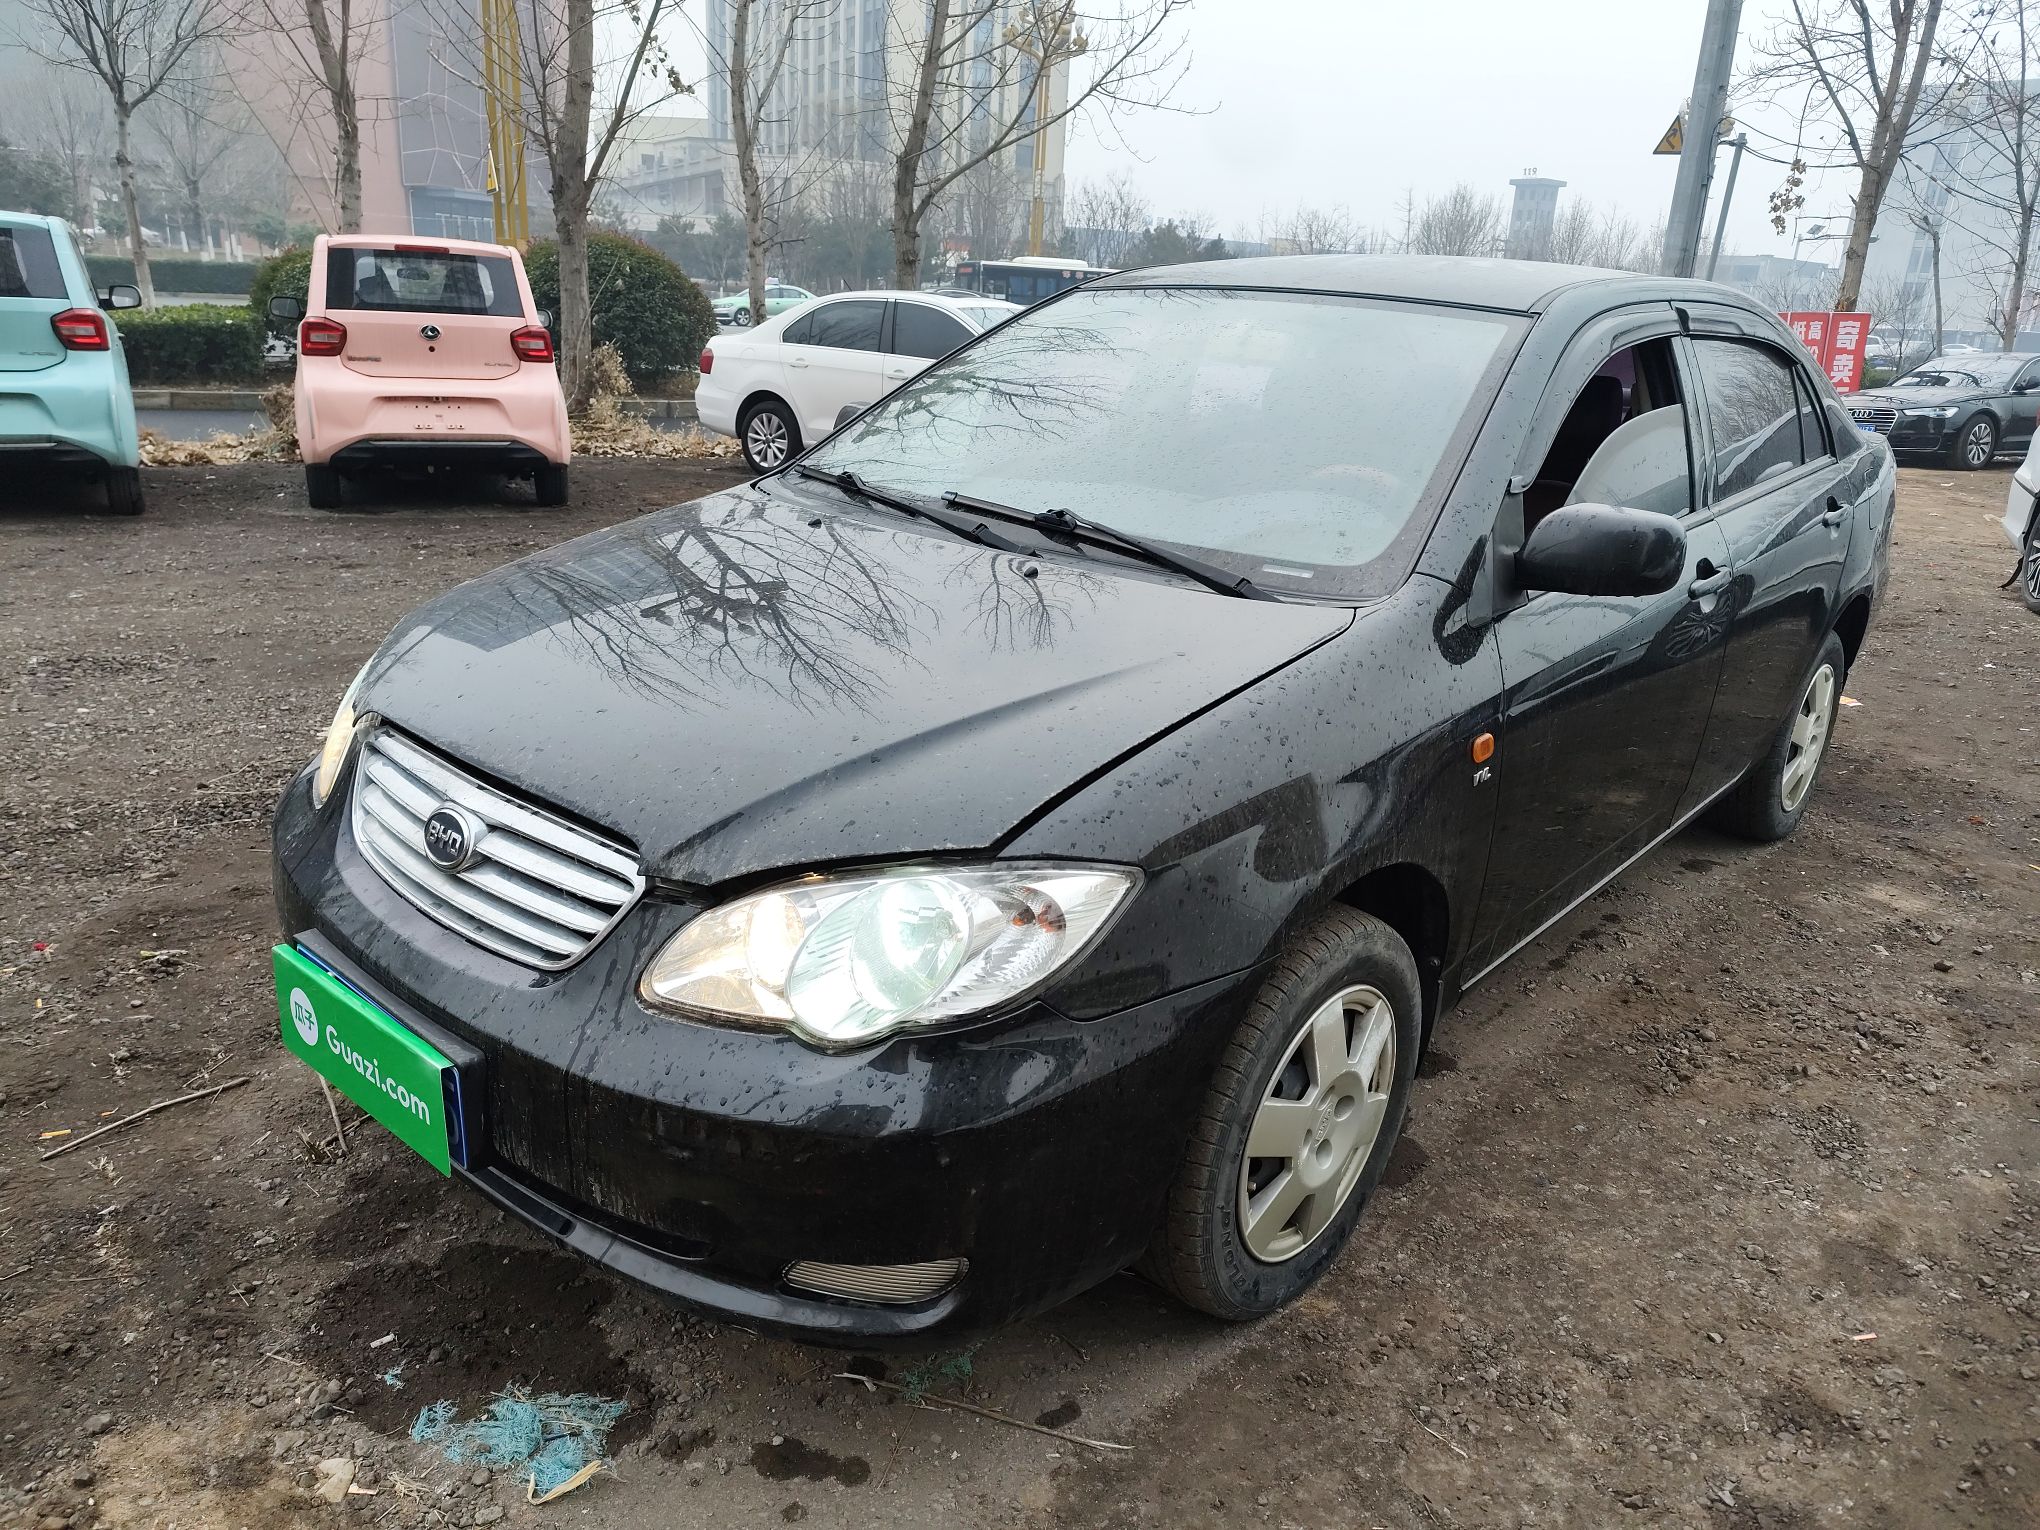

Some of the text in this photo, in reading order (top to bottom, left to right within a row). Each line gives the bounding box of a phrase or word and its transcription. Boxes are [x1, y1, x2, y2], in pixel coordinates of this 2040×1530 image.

[1522, 167, 1538, 176] 119
[427, 820, 462, 857] BYD
[293, 1001, 315, 1031] 瓜子
[325, 1024, 431, 1126] Guazi.com
